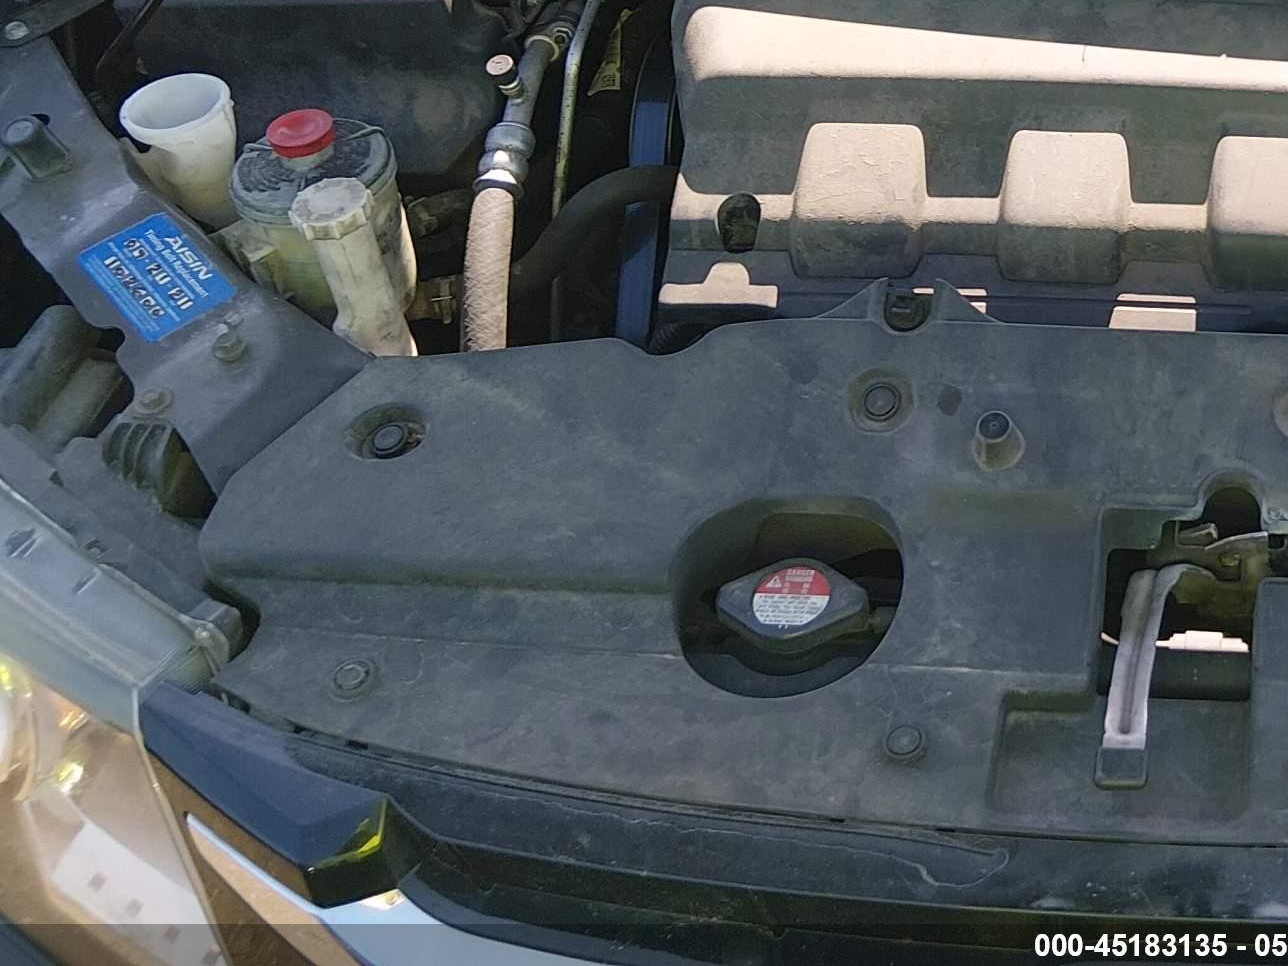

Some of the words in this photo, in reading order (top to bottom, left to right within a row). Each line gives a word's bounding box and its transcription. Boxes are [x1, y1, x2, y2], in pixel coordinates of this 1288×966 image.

[142, 229, 167, 251] Timing
[160, 248, 176, 262] Belt
[170, 260, 209, 298] Replacement
[163, 236, 213, 279] AISIN
